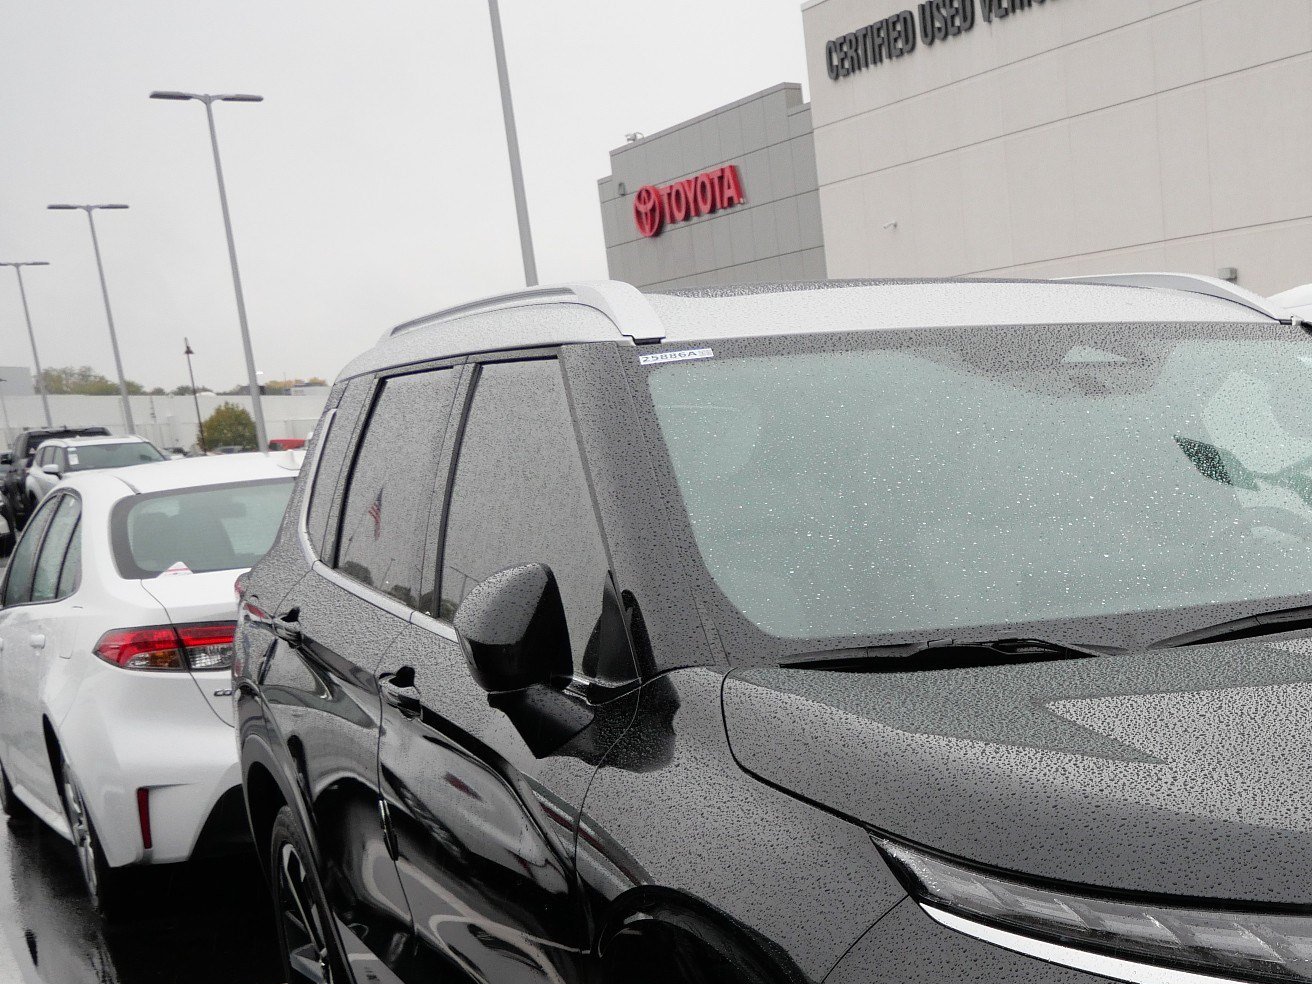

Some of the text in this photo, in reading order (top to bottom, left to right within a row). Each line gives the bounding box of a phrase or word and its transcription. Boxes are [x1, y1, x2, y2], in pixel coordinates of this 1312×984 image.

[825, 0, 975, 80] CERTIFIED USED
[660, 165, 743, 224] TOYOTA
